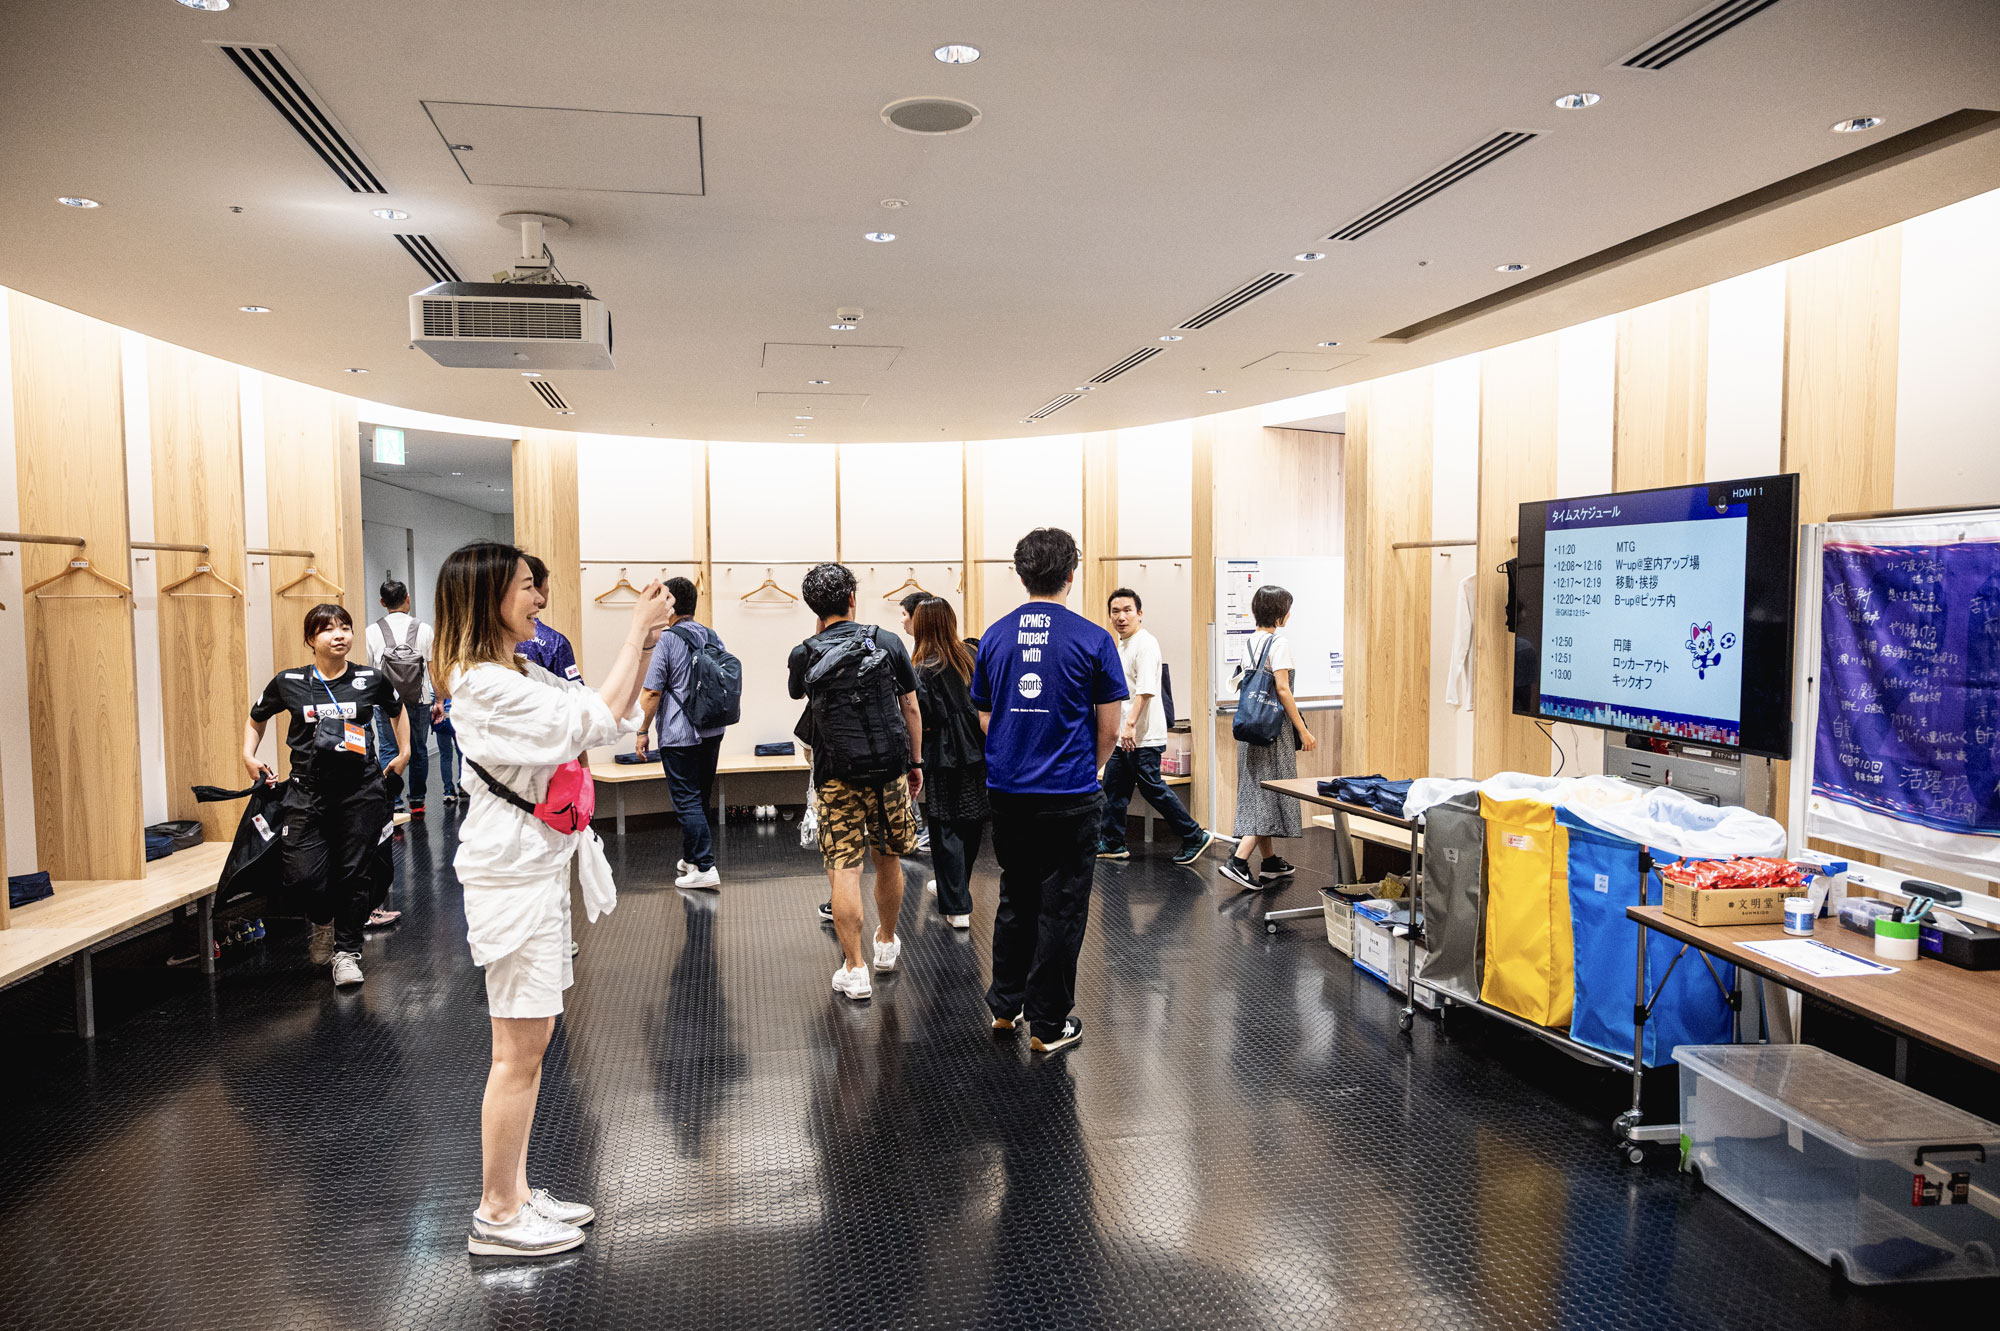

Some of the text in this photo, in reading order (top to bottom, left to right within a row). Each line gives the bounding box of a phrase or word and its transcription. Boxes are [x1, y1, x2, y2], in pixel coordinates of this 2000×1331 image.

[1732, 487, 1763, 498] HDMI 1
[1552, 506, 1621, 523] タイムスケジュール
[1616, 541, 1636, 553] MTG
[1615, 575, 1659, 589] 移動・挨拶
[1614, 593, 1676, 608] B-up@ピッチ内
[1019, 613, 1051, 628] KPMG's
[1613, 639, 1632, 652] 円陣
[1022, 647, 1042, 662] with
[1613, 657, 1669, 673] ロッカーアウト
[1018, 679, 1043, 692] sports
[1612, 673, 1653, 690] キックオフ
[1738, 898, 1773, 910] 文明堂
